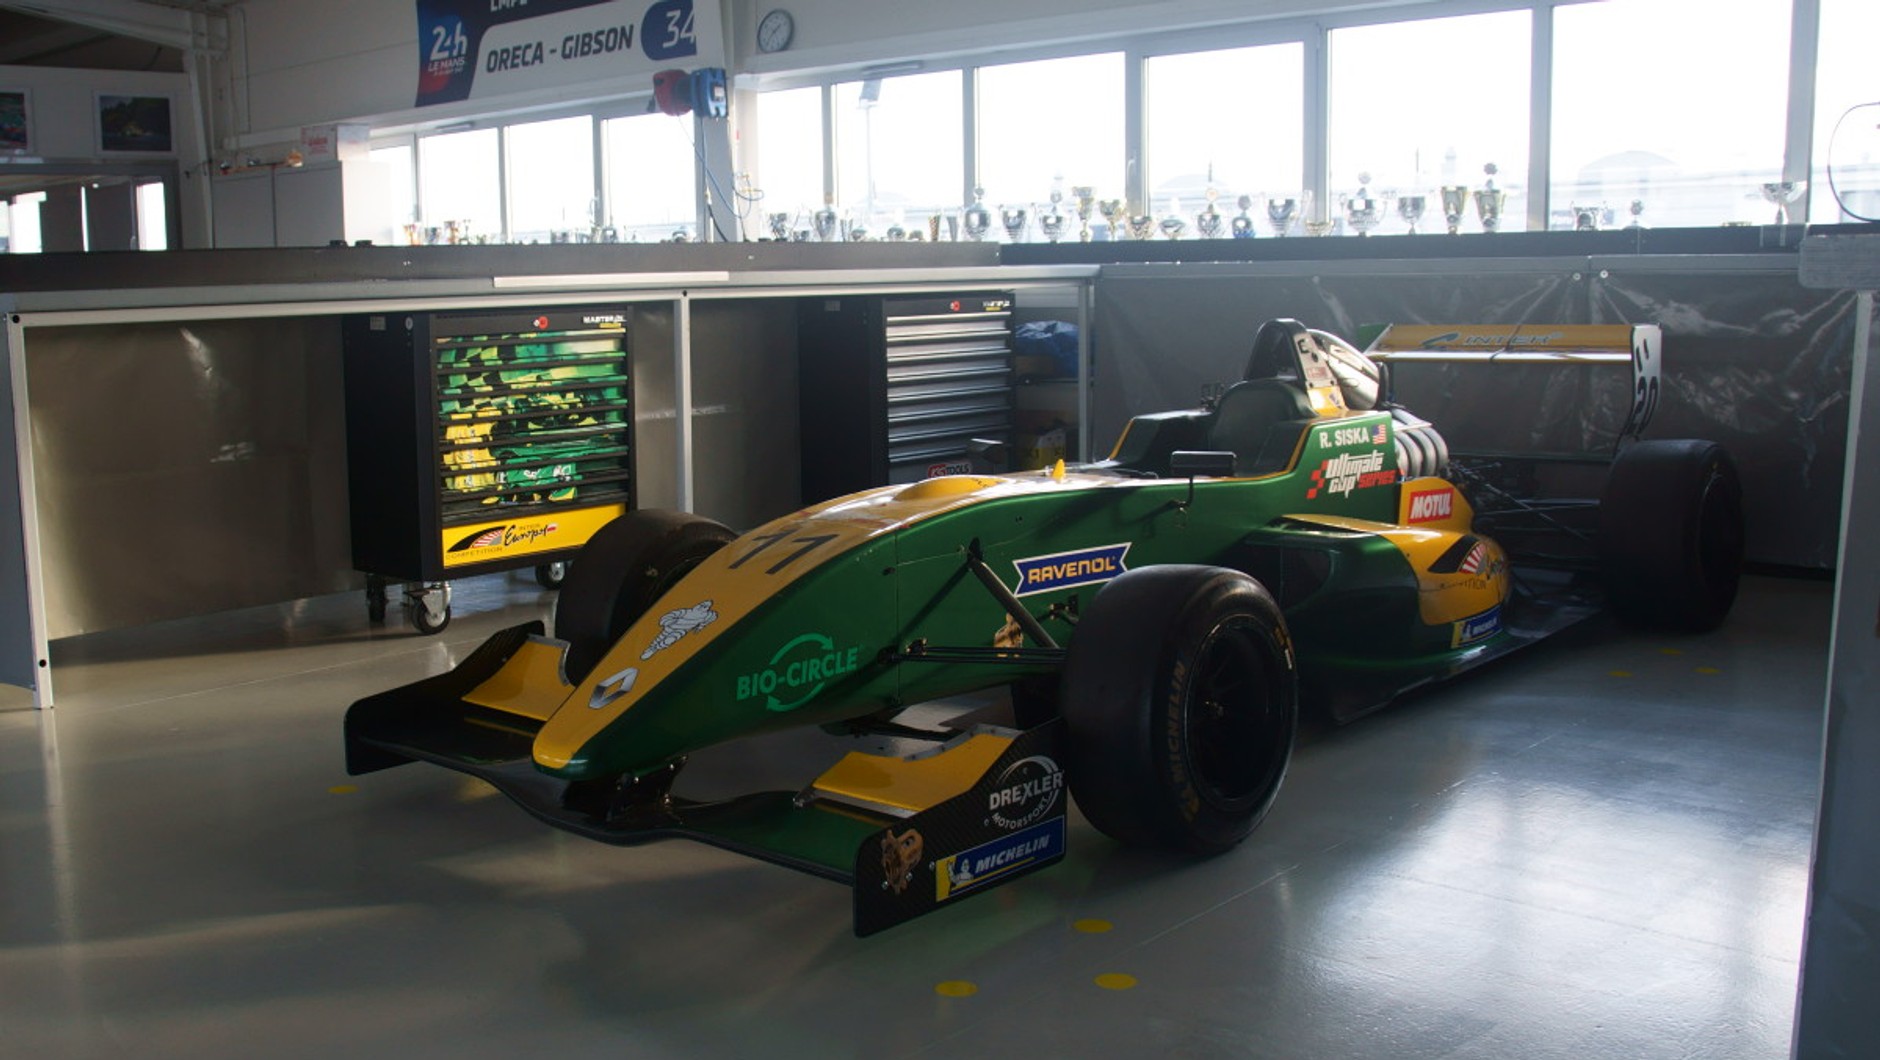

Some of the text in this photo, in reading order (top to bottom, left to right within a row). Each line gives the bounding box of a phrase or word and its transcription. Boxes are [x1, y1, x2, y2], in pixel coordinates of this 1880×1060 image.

[486, 41, 544, 73] ORECA
[561, 24, 634, 59] GIBSON
[662, 9, 695, 49] 34
[440, 56, 465, 70] MANS
[1319, 427, 1370, 449] R. SISKA
[1410, 493, 1452, 519] MOTUL
[728, 528, 840, 575] 11
[1028, 556, 1116, 584] RAVENOL
[736, 646, 859, 701] BIO-CIRCLE
[989, 772, 1064, 810] DREXLER
[975, 834, 1051, 874] MICHELIN
